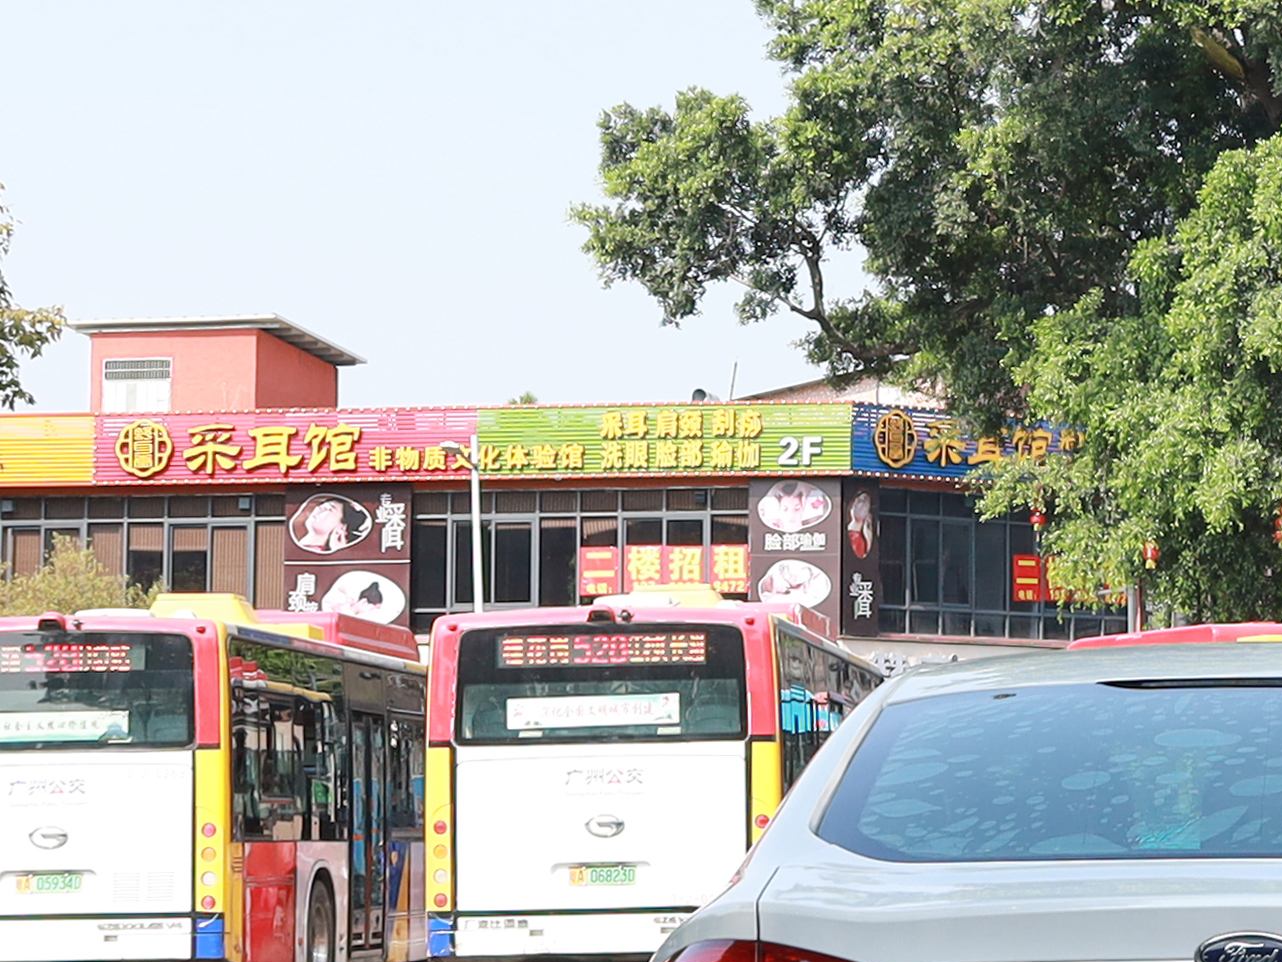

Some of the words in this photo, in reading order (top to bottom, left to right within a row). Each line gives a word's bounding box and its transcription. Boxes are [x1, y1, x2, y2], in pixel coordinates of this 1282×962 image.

[599, 411, 649, 439] 采耳
[655, 410, 703, 438] 肩颈
[711, 409, 763, 438] 刮痧
[183, 422, 361, 475] 采耳馆
[368, 442, 586, 471] 非物质文化体验馆
[600, 441, 650, 469] 洗眼
[655, 440, 703, 468] 脸部
[709, 440, 761, 468] 瑜伽
[777, 435, 824, 466] 2F
[764, 532, 827, 551] 脸部瑜伽
[583, 546, 747, 582] 二楼招租
[8, 778, 86, 796] 广州公交
[565, 767, 644, 786] 广州公交
